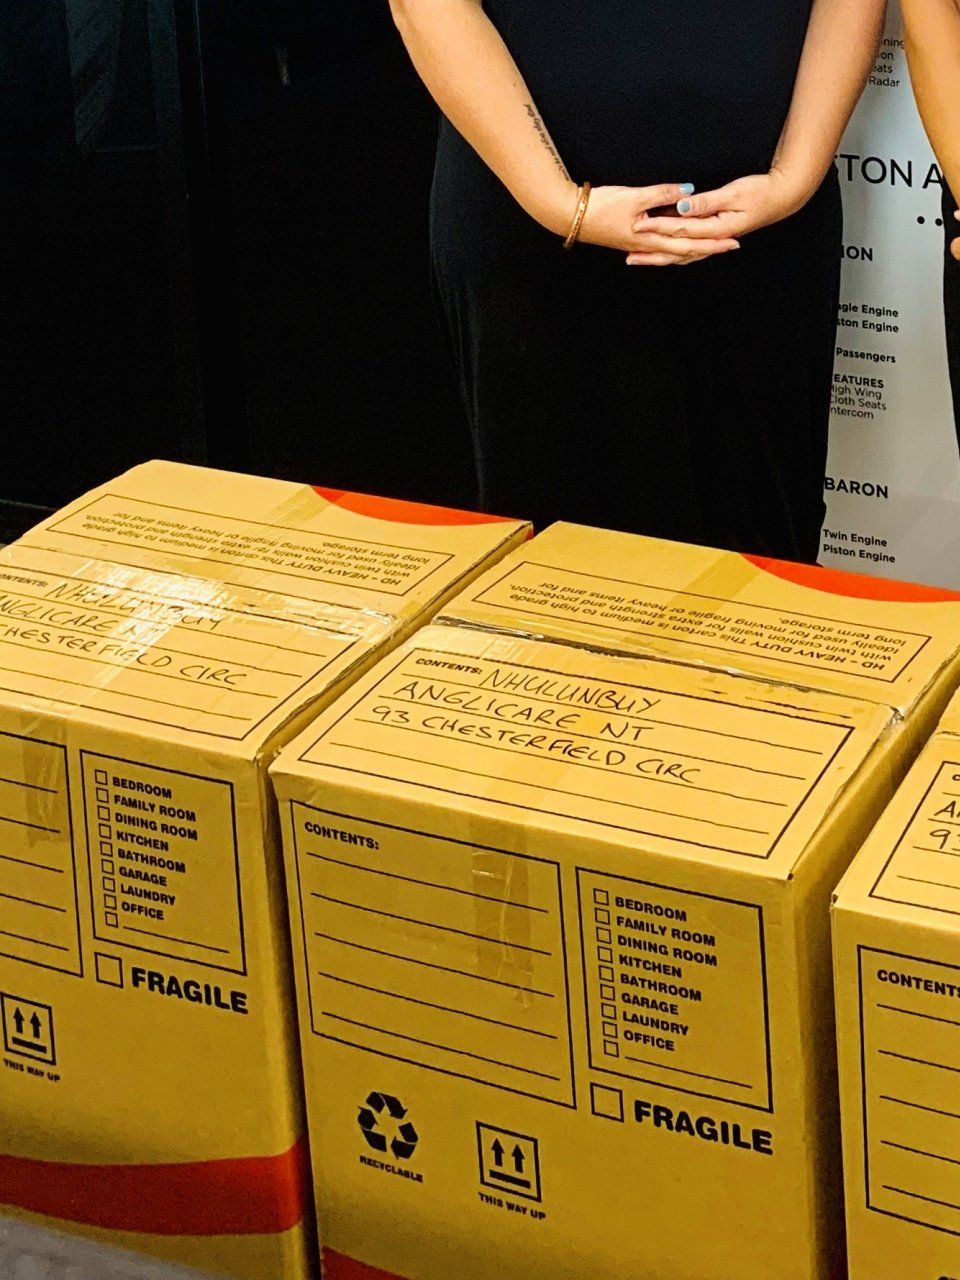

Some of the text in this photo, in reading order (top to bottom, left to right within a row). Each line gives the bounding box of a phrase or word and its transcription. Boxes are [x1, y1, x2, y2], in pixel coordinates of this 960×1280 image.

[836, 153, 913, 188] TON
[862, 304, 899, 317] Engine
[862, 320, 899, 333] Engine
[836, 347, 896, 363] Passengers
[855, 387, 882, 400] Wing
[858, 398, 887, 411] Seats
[825, 477, 888, 499] BARON
[823, 529, 887, 547] Twin Engine
[823, 544, 896, 563] Piston Engine
[578, 598, 607, 608] and
[607, 603, 666, 619] strength
[537, 581, 900, 655] Ideally used for moving fragile or heavy items and for
[667, 614, 704, 626] extra
[703, 621, 727, 632] for
[508, 592, 886, 671] HD HEAVY DUTY This carton is medium to high grade
[727, 625, 764, 638] walls
[766, 632, 823, 649] cushion
[778, 617, 907, 647] long term storage.
[0, 624, 247, 685] HESTERFIELD CIRC
[824, 643, 857, 656] twin
[859, 650, 892, 662] with
[415, 658, 482, 674] CONTENTS:
[479, 669, 660, 714] NHULUNBUY
[393, 681, 654, 742] ANGLICARE NT
[372, 705, 700, 784] 93 CHESTERFIELD CIRC
[112, 778, 171, 798] BEDROOM
[113, 796, 196, 821] FAMILY ROOM
[114, 814, 197, 839] DINING ROOM
[304, 821, 379, 850] CONTENTS:
[115, 832, 168, 850] KITCHEN
[117, 849, 185, 872] BATHROOM
[118, 868, 167, 885] GARAGE
[120, 885, 175, 904] LAUNDRY
[120, 902, 164, 919] OFFICE
[614, 898, 686, 920] BEDROOM
[616, 917, 715, 945] FAMILY ROOM
[617, 936, 717, 964] DINING ROOM
[618, 955, 682, 977] KITCHEN
[131, 968, 248, 1013] FRAGILE
[620, 975, 701, 1000] BATHROOM
[620, 994, 678, 1013] GARAGE
[622, 1012, 688, 1033] LAUNDRY
[623, 1031, 674, 1050] OFFICE
[47, 1072, 61, 1082] UP
[633, 1101, 773, 1154] FRAGILE
[359, 1155, 423, 1182] RECYCLABLE
[477, 1191, 546, 1220] THIS WAY UP
